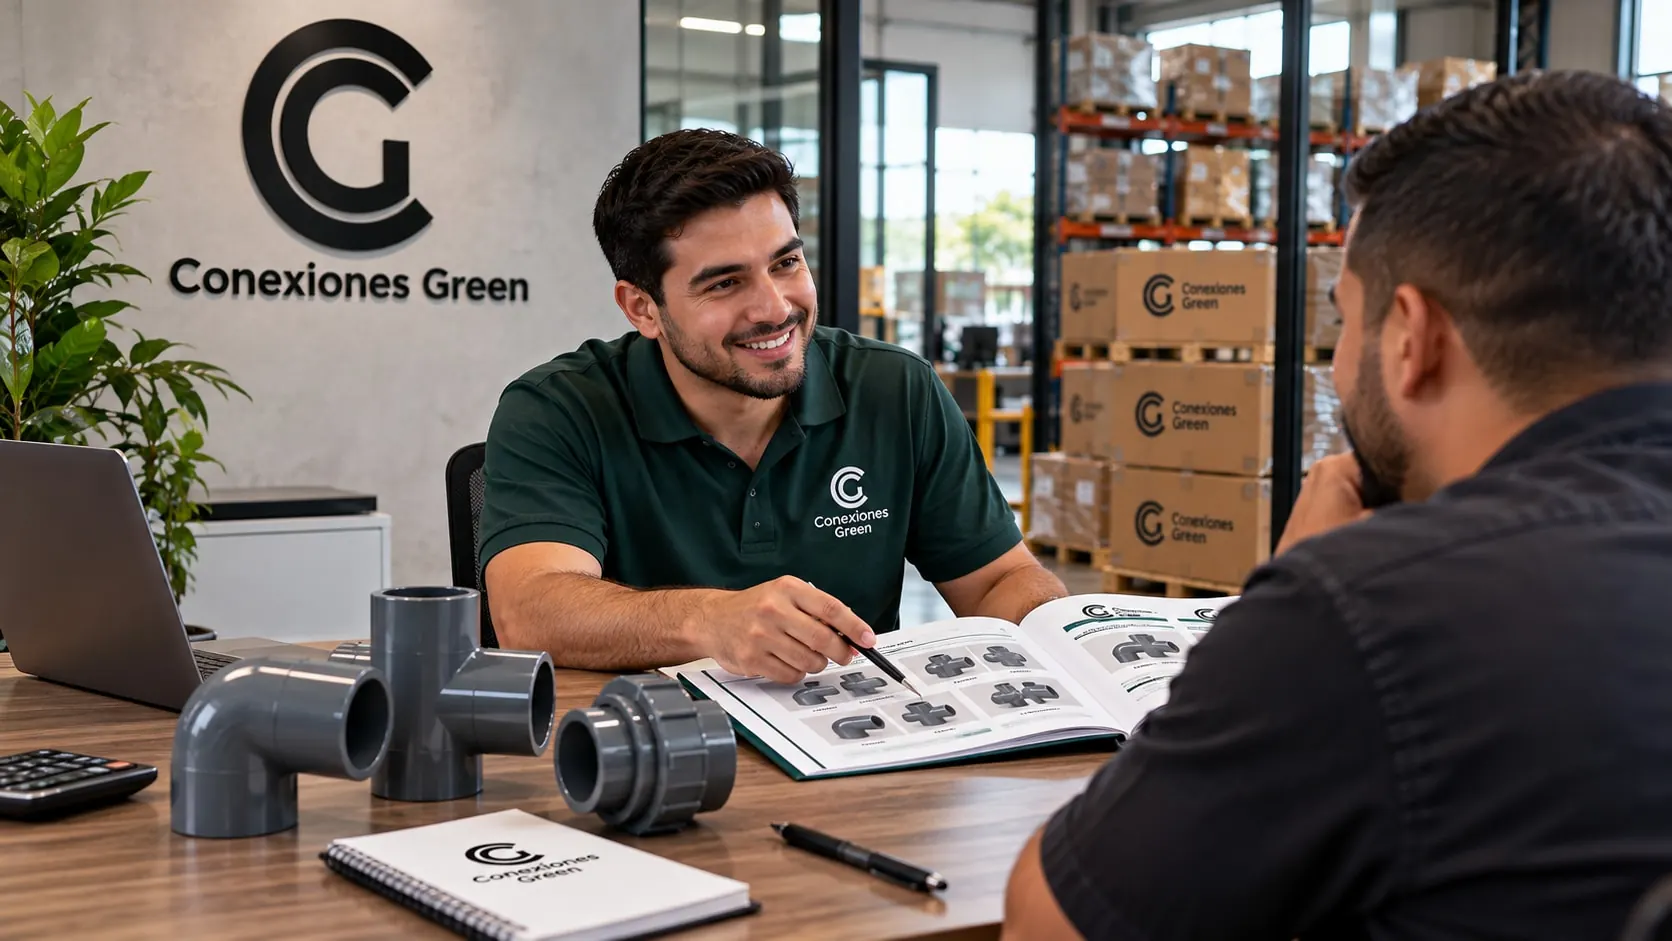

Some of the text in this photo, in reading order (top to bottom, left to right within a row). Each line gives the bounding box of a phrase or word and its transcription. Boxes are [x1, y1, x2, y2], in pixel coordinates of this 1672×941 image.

[169, 257, 530, 302] Conexiones Green
[1181, 281, 1246, 296] Conexiones
[1181, 297, 1219, 310] Green
[1172, 401, 1237, 417] Conexiones
[1172, 416, 1209, 431] Green
[814, 508, 889, 528] Conexiones
[1171, 511, 1235, 532] Conexiones
[834, 524, 872, 538] Green
[1171, 528, 1207, 544] Green
[472, 853, 600, 884] Conexiones
[516, 866, 583, 883] Green
